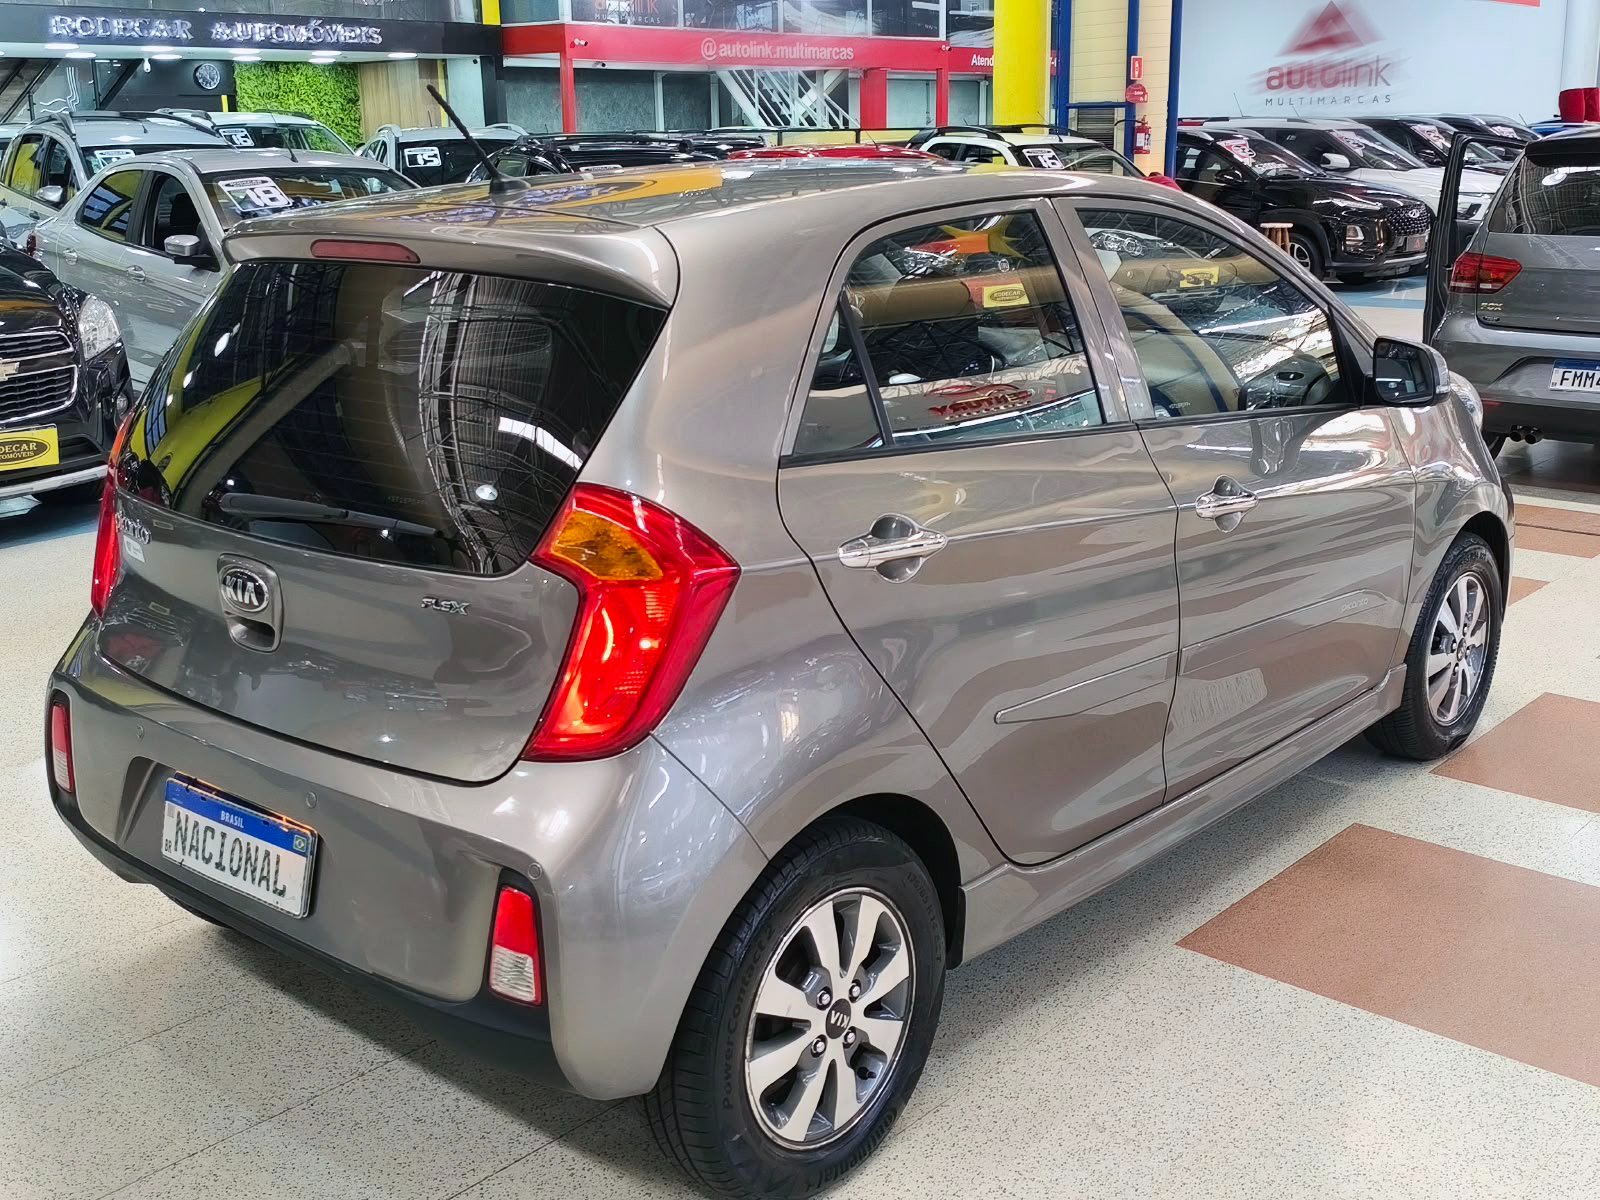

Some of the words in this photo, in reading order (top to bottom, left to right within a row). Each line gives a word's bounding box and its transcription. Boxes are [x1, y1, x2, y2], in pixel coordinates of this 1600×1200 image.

[50, 15, 194, 40] RODECAR
[1266, 56, 1392, 90] autolink
[1265, 94, 1392, 107] MULTIMARCAS
[416, 153, 439, 166] 15
[245, 186, 290, 207] 18
[225, 575, 259, 606] KIA
[421, 598, 470, 616] FLEX
[220, 810, 244, 829] BRASIL
[174, 810, 287, 897] NACIONAL
